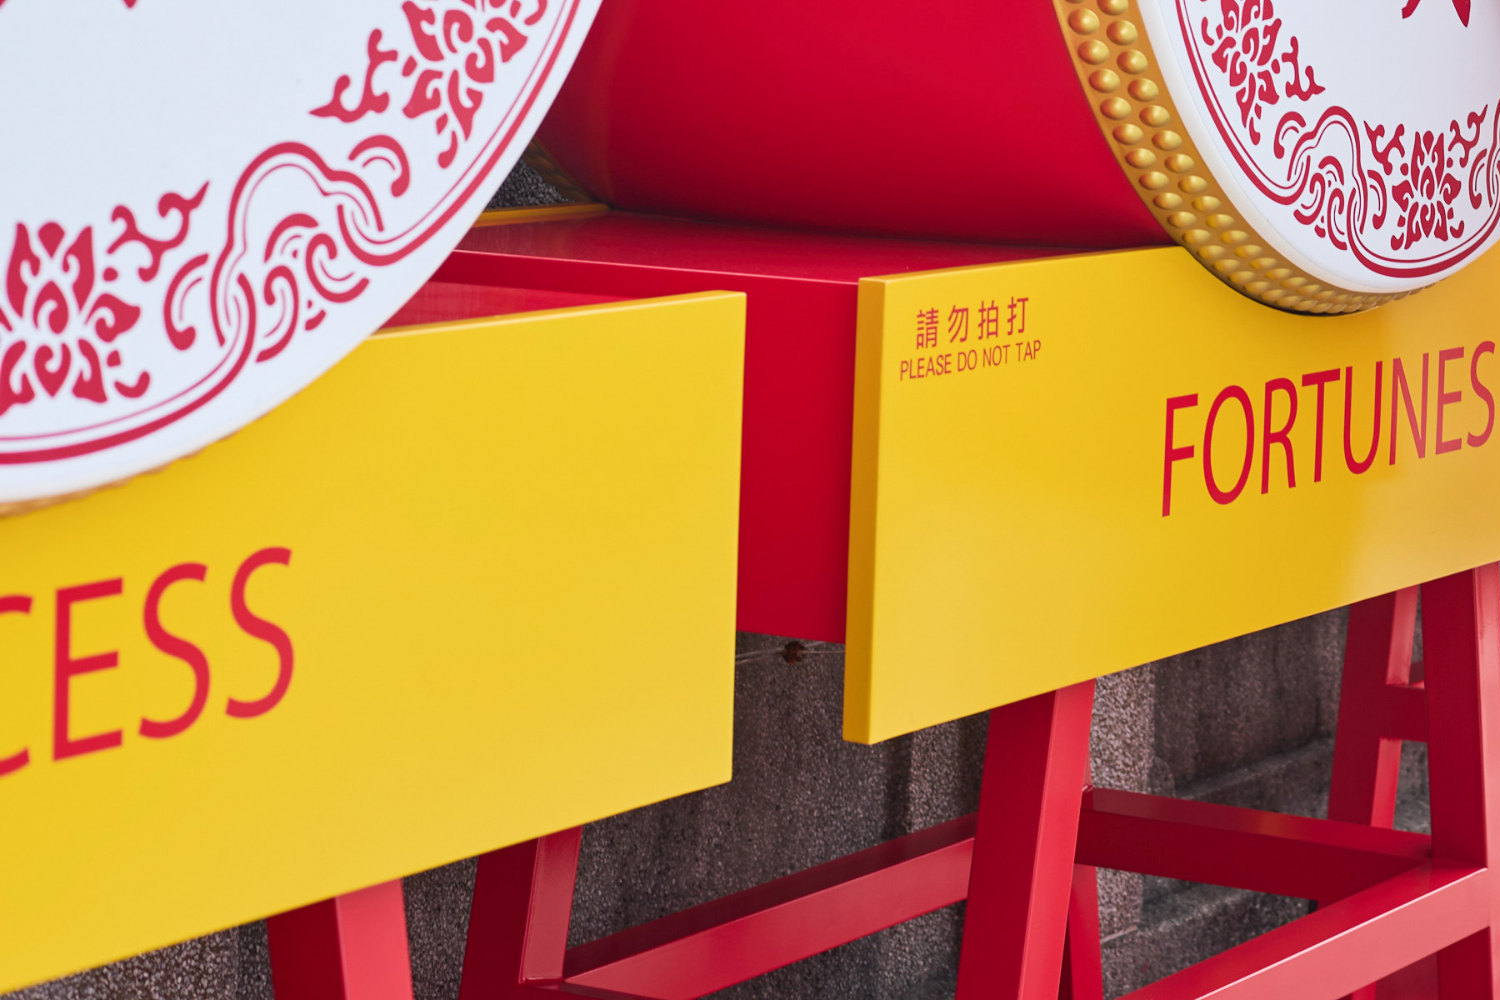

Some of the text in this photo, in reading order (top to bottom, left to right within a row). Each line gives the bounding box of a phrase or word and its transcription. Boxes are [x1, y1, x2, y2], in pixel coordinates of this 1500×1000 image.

[916, 296, 1029, 349] 請勿拍打
[900, 339, 1042, 381] PLEASE DO NOT TAP
[1162, 340, 1496, 517] FORTUNES
